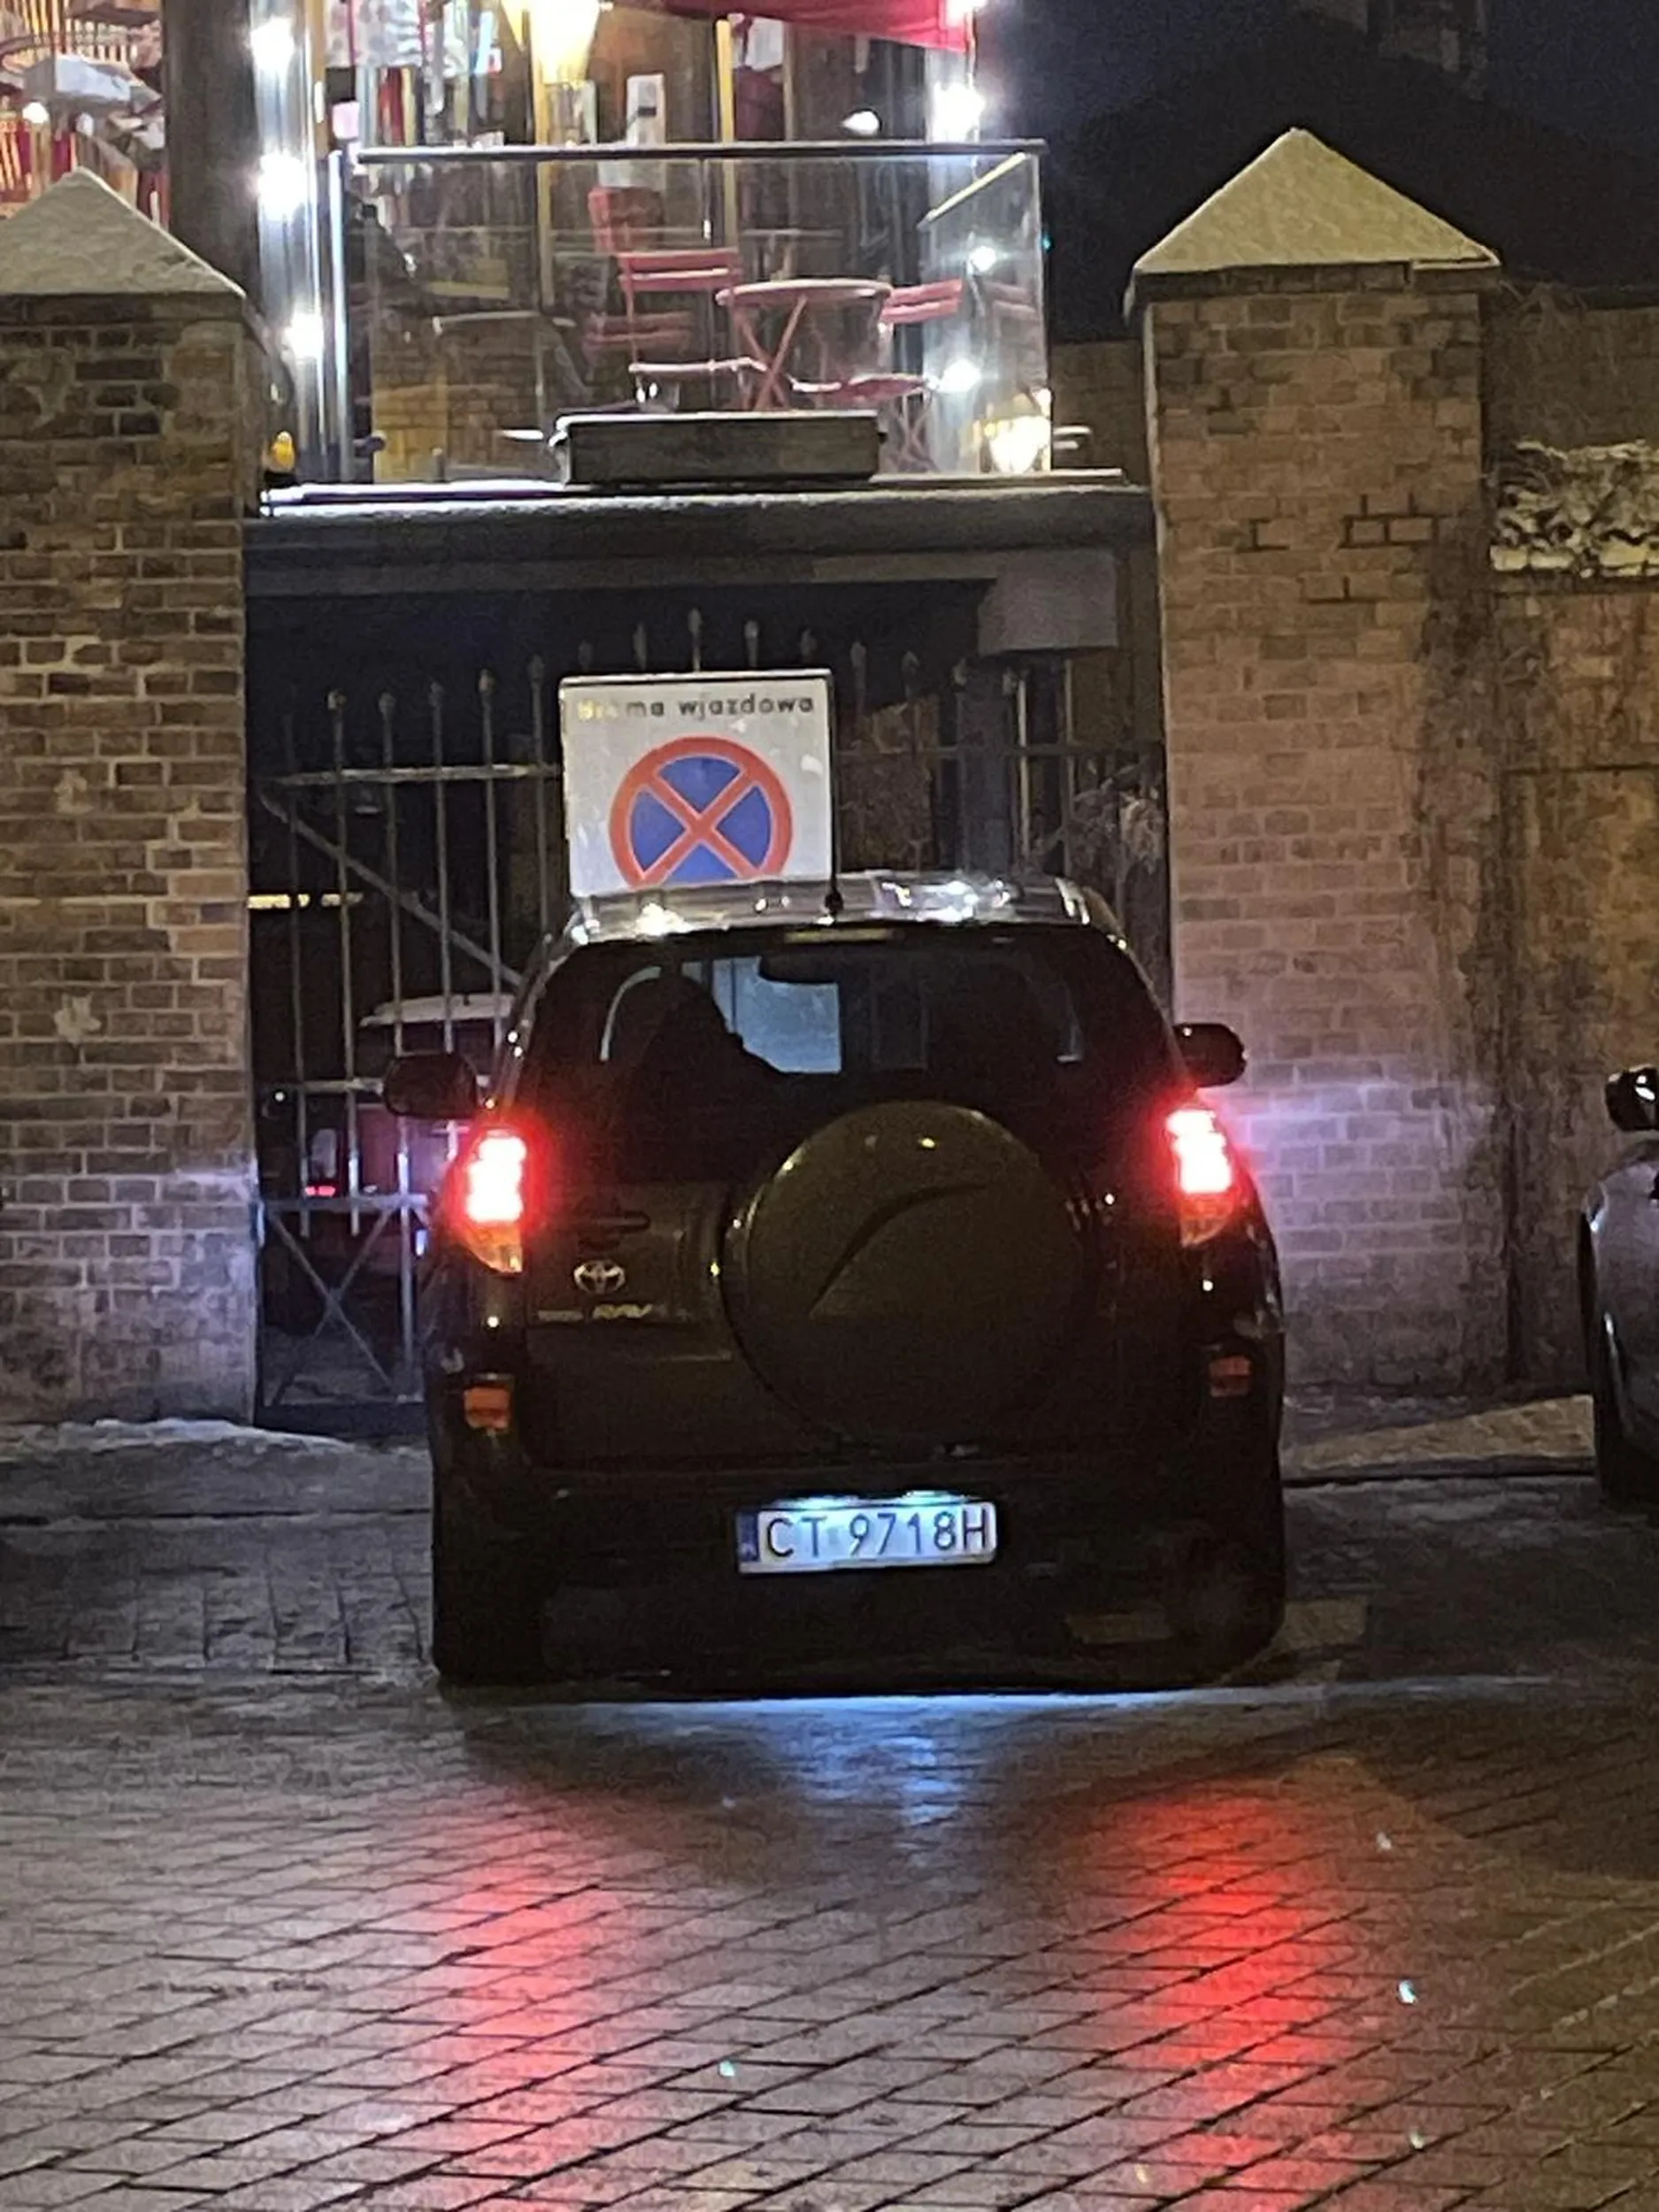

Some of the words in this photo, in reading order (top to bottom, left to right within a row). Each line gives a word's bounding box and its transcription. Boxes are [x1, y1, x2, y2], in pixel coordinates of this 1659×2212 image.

[679, 693, 813, 721] wjazdowa
[766, 1516, 827, 1557] CT
[849, 1509, 987, 1555] 9718H
